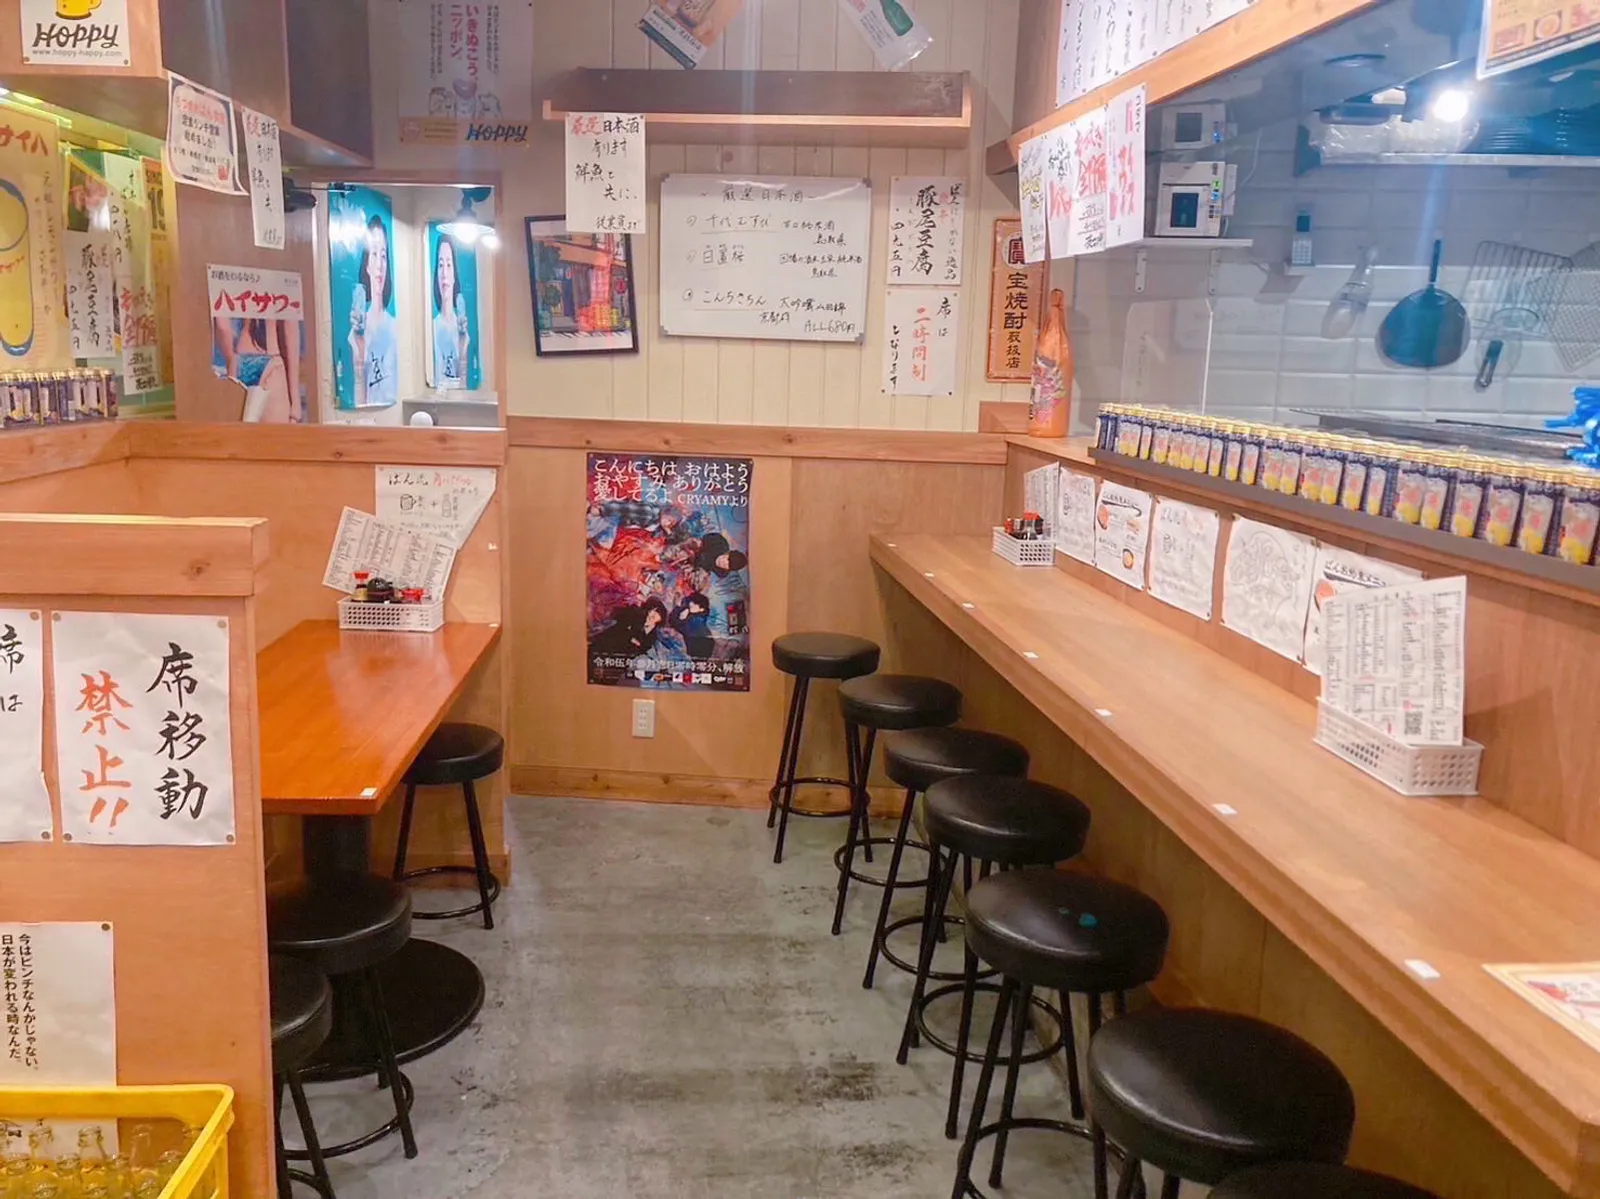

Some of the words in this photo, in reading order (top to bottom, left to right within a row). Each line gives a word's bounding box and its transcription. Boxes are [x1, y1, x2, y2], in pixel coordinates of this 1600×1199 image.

[32, 23, 119, 48] Hoppy
[32, 49, 122, 58] www.hoppy-happy.com
[465, 123, 528, 142] Hoppy
[213, 289, 300, 313] ハイサワー
[1004, 272, 1029, 369] 宝焼酎取扱店
[911, 307, 932, 382] 二時間制
[594, 459, 677, 475] こんにちは
[685, 462, 749, 479] おはよう
[594, 473, 666, 490] おやすみ
[673, 476, 749, 493] ありがとう
[594, 486, 672, 503] 愛してるよ
[677, 493, 748, 507] CRYAMYより
[145, 642, 208, 820] 席移動
[1, 934, 22, 1063] 日本が変われる時なんだ。
[18, 933, 39, 1070] 今はピンチなんかじゃない。
